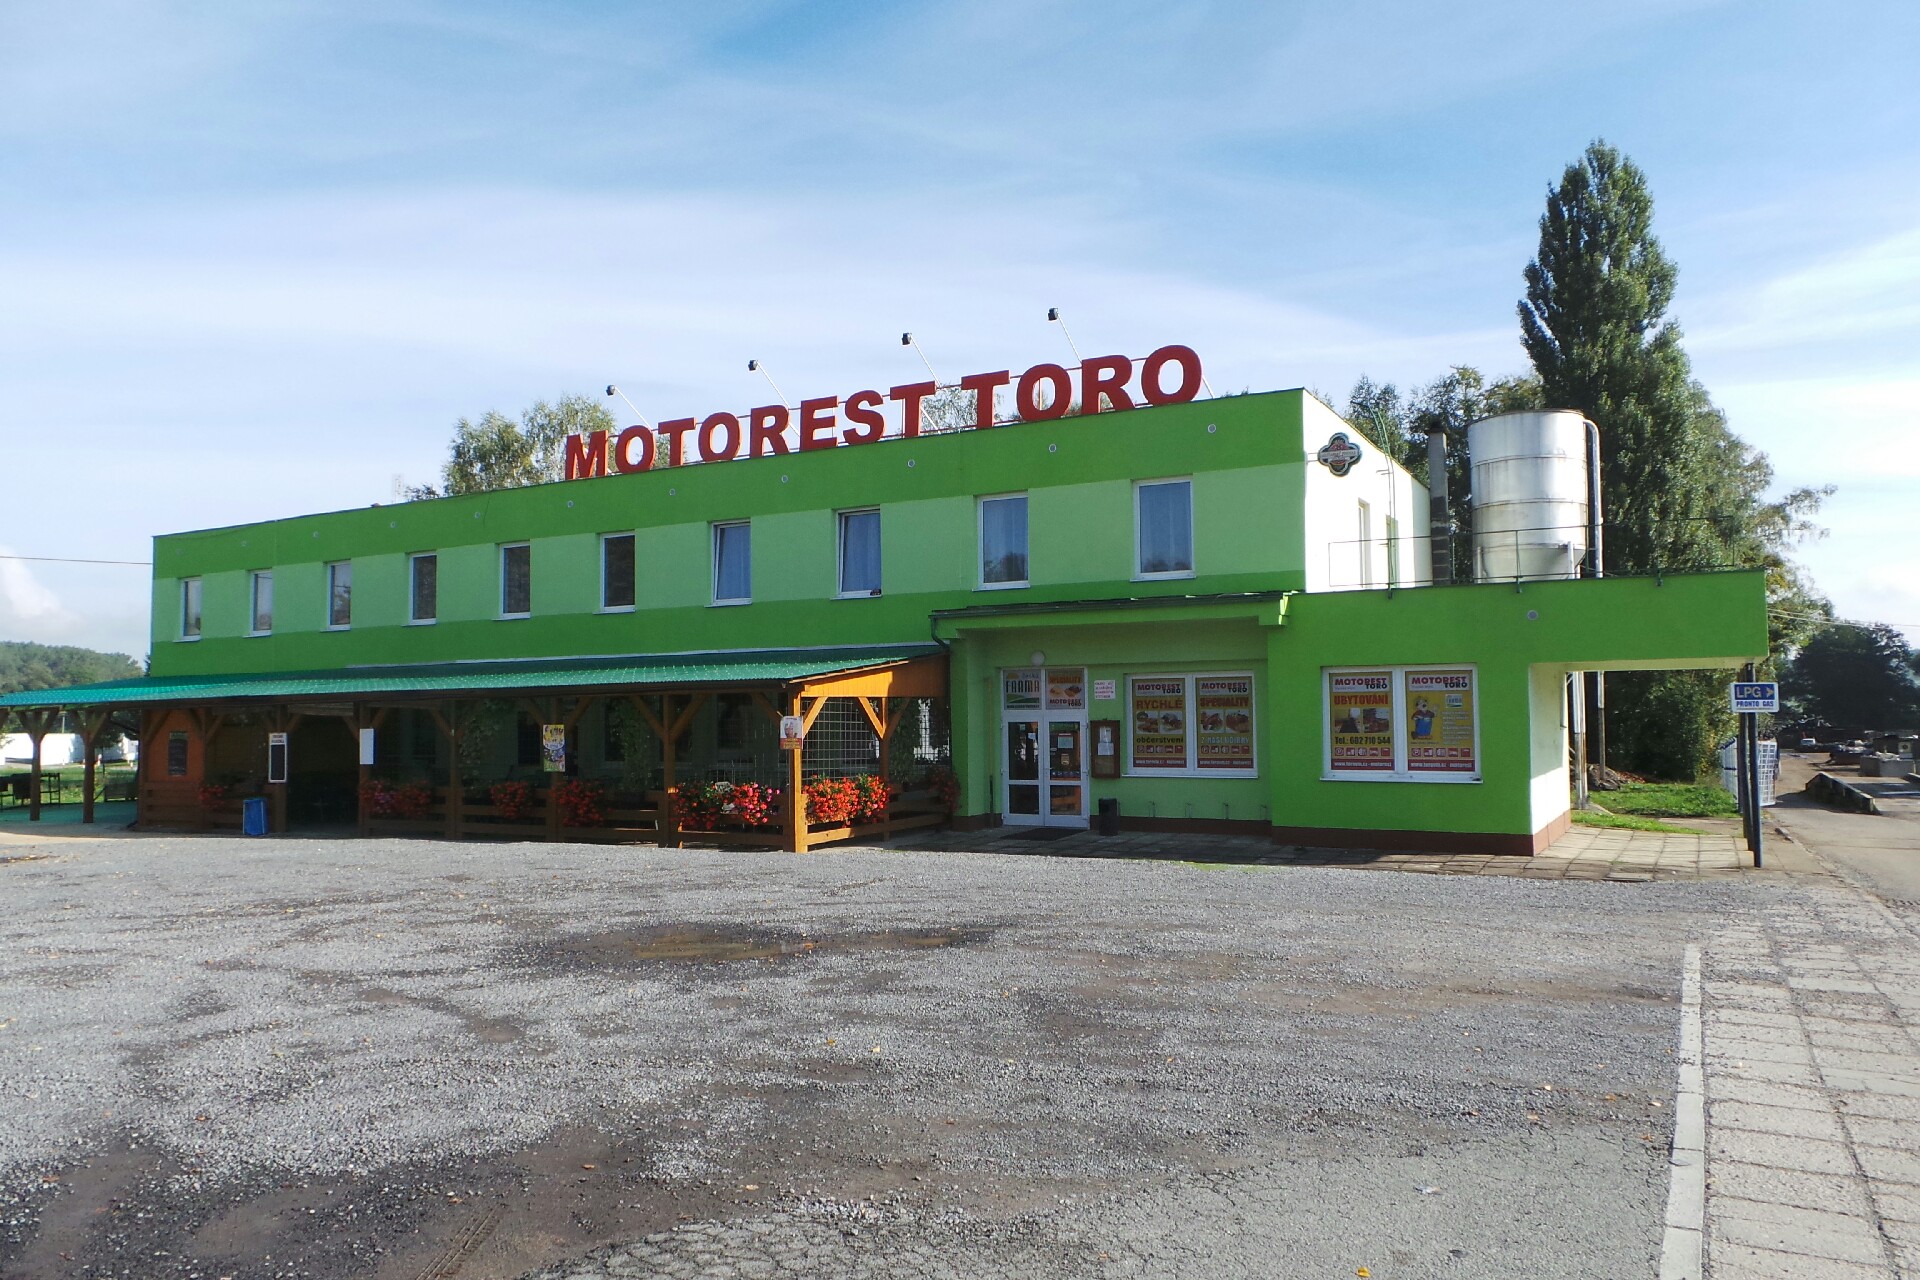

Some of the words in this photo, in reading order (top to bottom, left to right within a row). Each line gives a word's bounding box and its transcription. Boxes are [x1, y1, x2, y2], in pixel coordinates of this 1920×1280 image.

[565, 380, 937, 480] MOTOREST
[961, 344, 1202, 429] TORO
[1334, 677, 1387, 686] MOTOREST
[1411, 676, 1467, 685] MOTOREST
[1006, 680, 1040, 693] FARMA
[1137, 683, 1181, 691] MOTOREST
[1201, 682, 1247, 690] MOTOREST
[1736, 686, 1762, 698] LPG
[1136, 698, 1183, 709] RYCHLÉ
[1136, 736, 1184, 744] občerstvení
